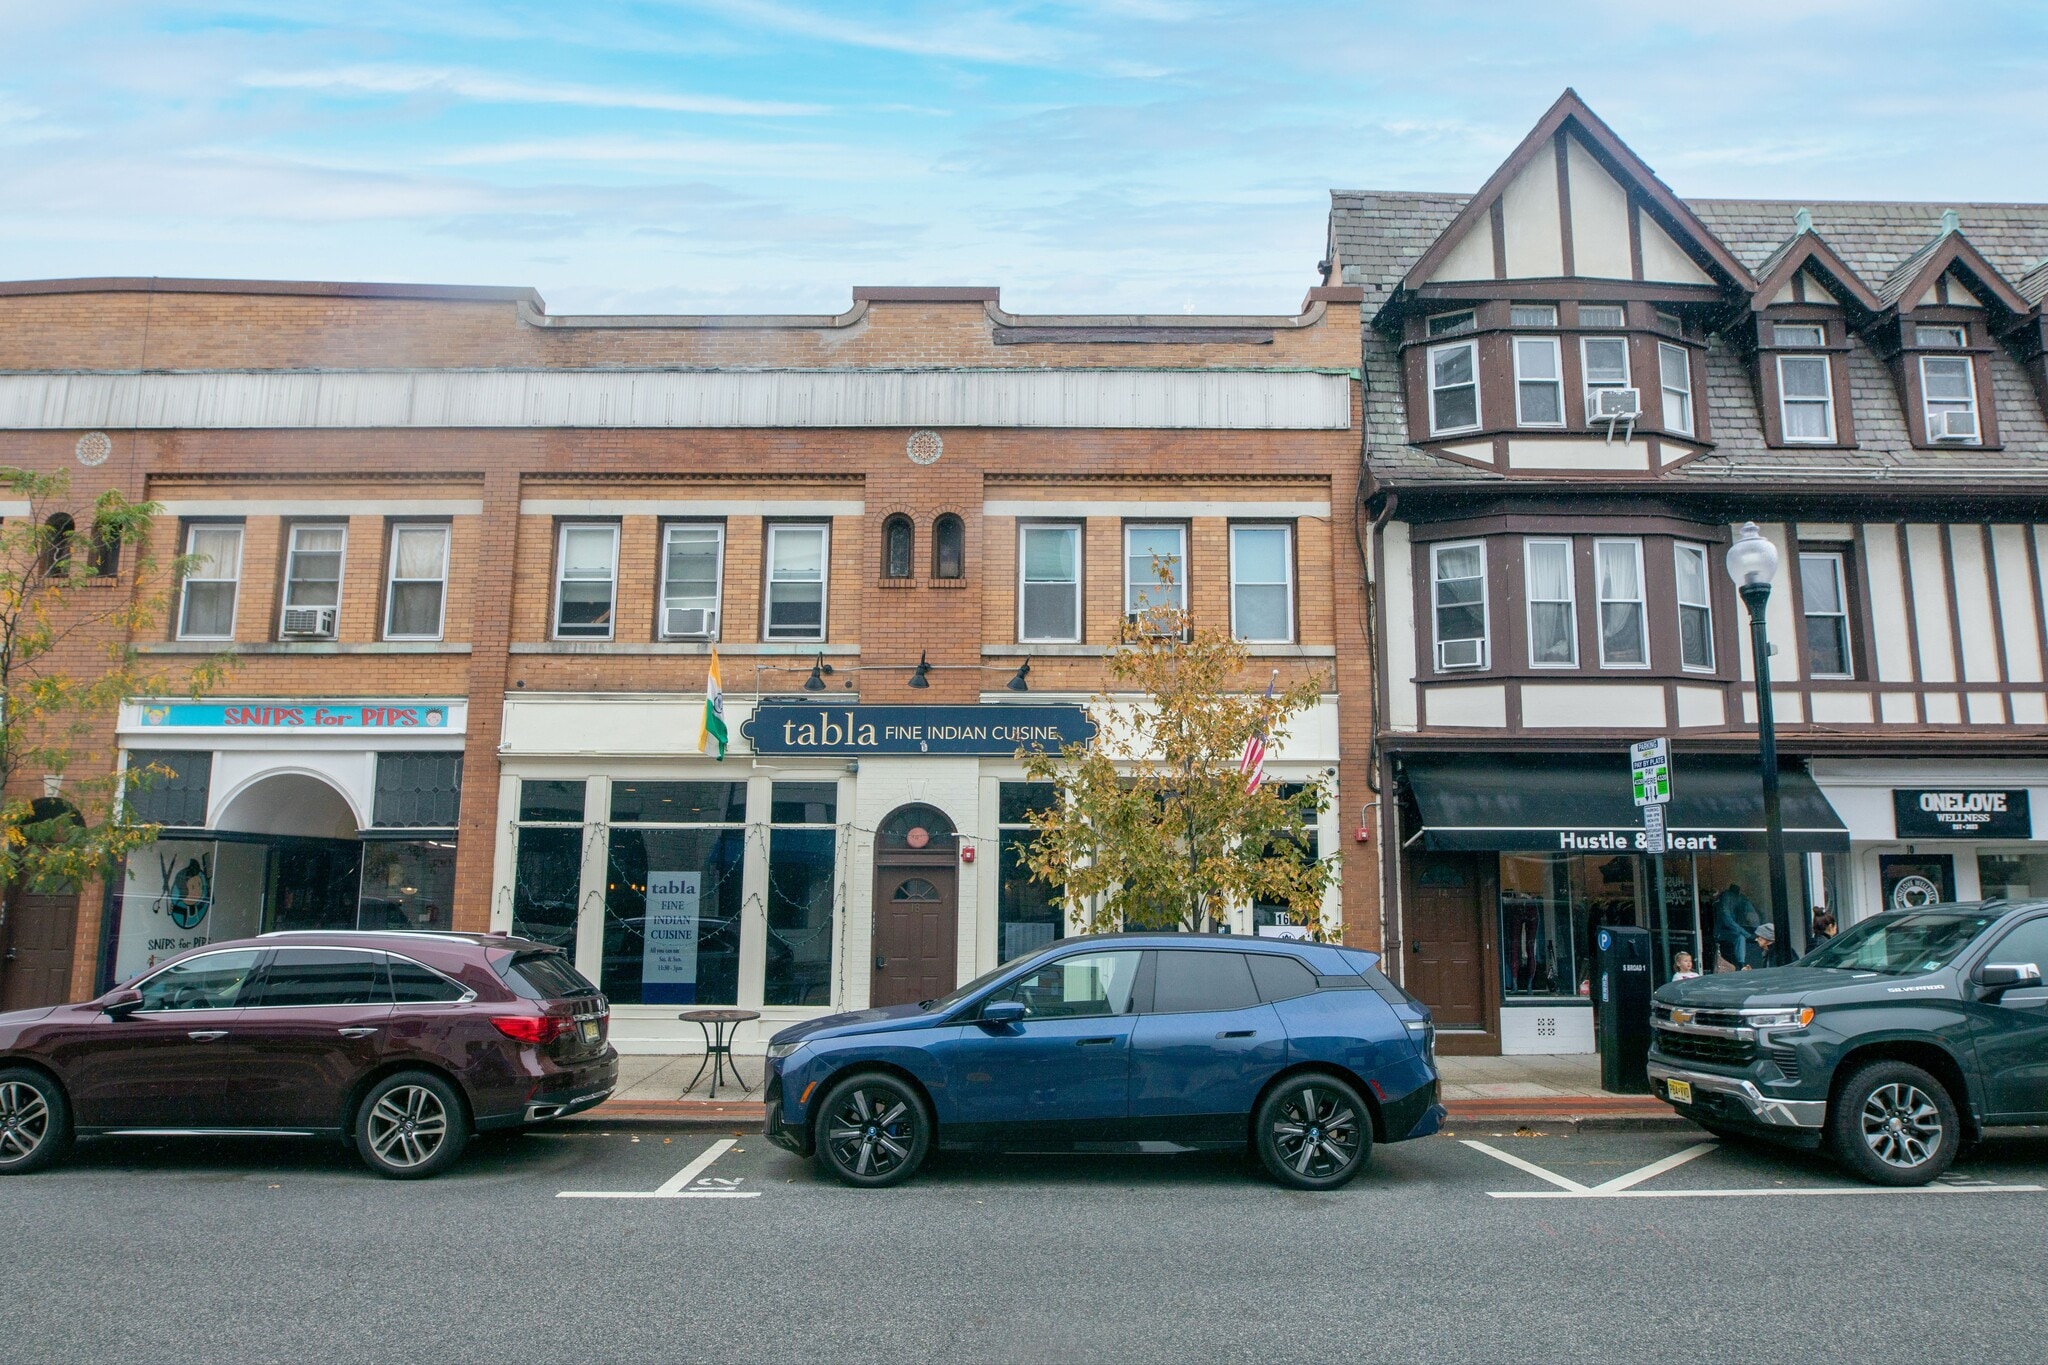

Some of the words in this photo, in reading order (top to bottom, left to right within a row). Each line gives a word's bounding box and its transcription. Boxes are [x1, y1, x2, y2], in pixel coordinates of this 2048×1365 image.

[312, 708, 353, 726] for
[783, 711, 879, 746] tabla
[885, 726, 922, 740] FINE
[928, 726, 987, 740] INDIAN
[992, 726, 1058, 740] CUISINE
[1638, 741, 1657, 751] PARKING
[1634, 761, 1642, 769] PAY
[1650, 756, 1665, 766] PLATE
[1645, 777, 1656, 785] HERE
[1920, 793, 2007, 812] ONELOVE
[1937, 813, 1990, 822] WELLNESS
[1560, 832, 1627, 849] Hustle
[1635, 832, 1648, 849] &
[652, 880, 696, 894] tabla
[661, 901, 684, 910] FINE
[911, 903, 920, 912] 18
[654, 915, 690, 924] INDIAN
[1277, 914, 1289, 925] 16
[651, 930, 692, 939] CUISINE
[178, 938, 191, 949] for
[1887, 984, 1945, 993] SILVERADO
